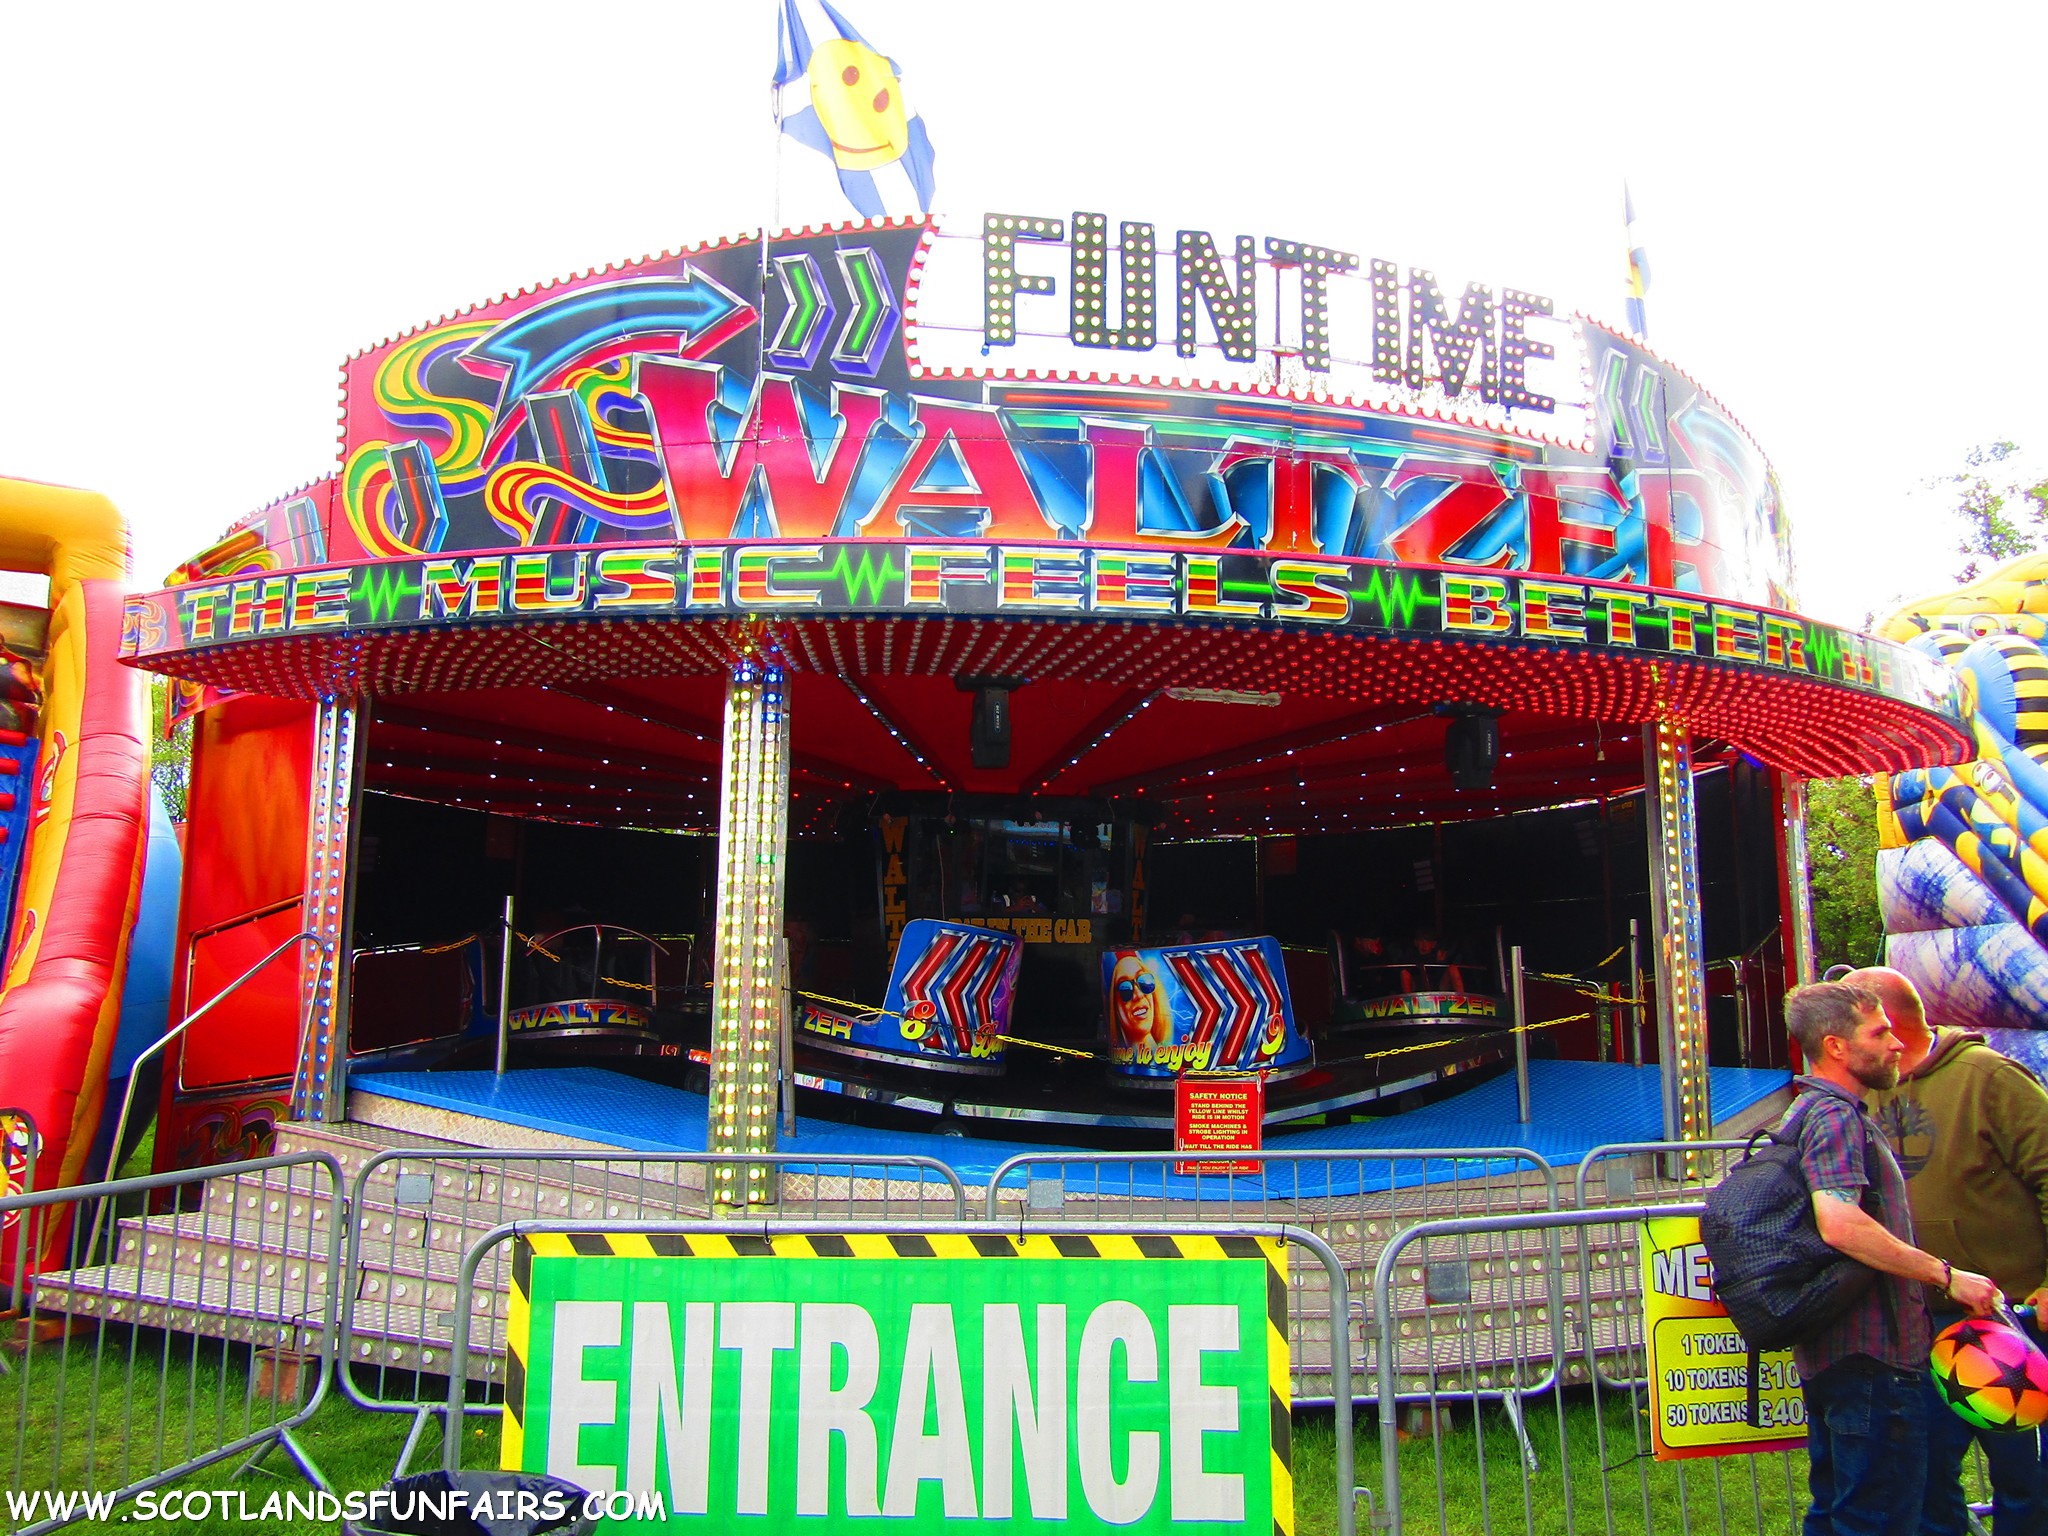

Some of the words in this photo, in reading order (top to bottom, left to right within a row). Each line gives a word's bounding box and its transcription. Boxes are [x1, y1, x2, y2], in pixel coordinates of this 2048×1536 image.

[983, 211, 1556, 414] FUNTIME
[632, 353, 1722, 596] WALTZER
[181, 566, 354, 642] THE
[420, 545, 826, 621] MUSIC
[903, 545, 1353, 625] FEELS
[1440, 572, 1810, 674] BETTER
[1054, 917, 1093, 944] CAR
[899, 999, 937, 1041] 8
[1362, 994, 1498, 1020] WALTZER
[1136, 1042, 1153, 1065] to
[1153, 1033, 1213, 1072] enjoy
[1261, 1012, 1285, 1056] 9
[1189, 1092, 1218, 1100] SAFETY
[1652, 1241, 1716, 1301] ME
[1681, 1334, 1692, 1355] 1
[1665, 1368, 1686, 1391] 10
[1686, 1366, 1749, 1390] TOKENS
[547, 1300, 1247, 1525] ENTRANCE
[1667, 1404, 1687, 1427] 50
[1688, 1401, 1749, 1425] TOKENS
[1758, 1397, 1807, 1428] £40
